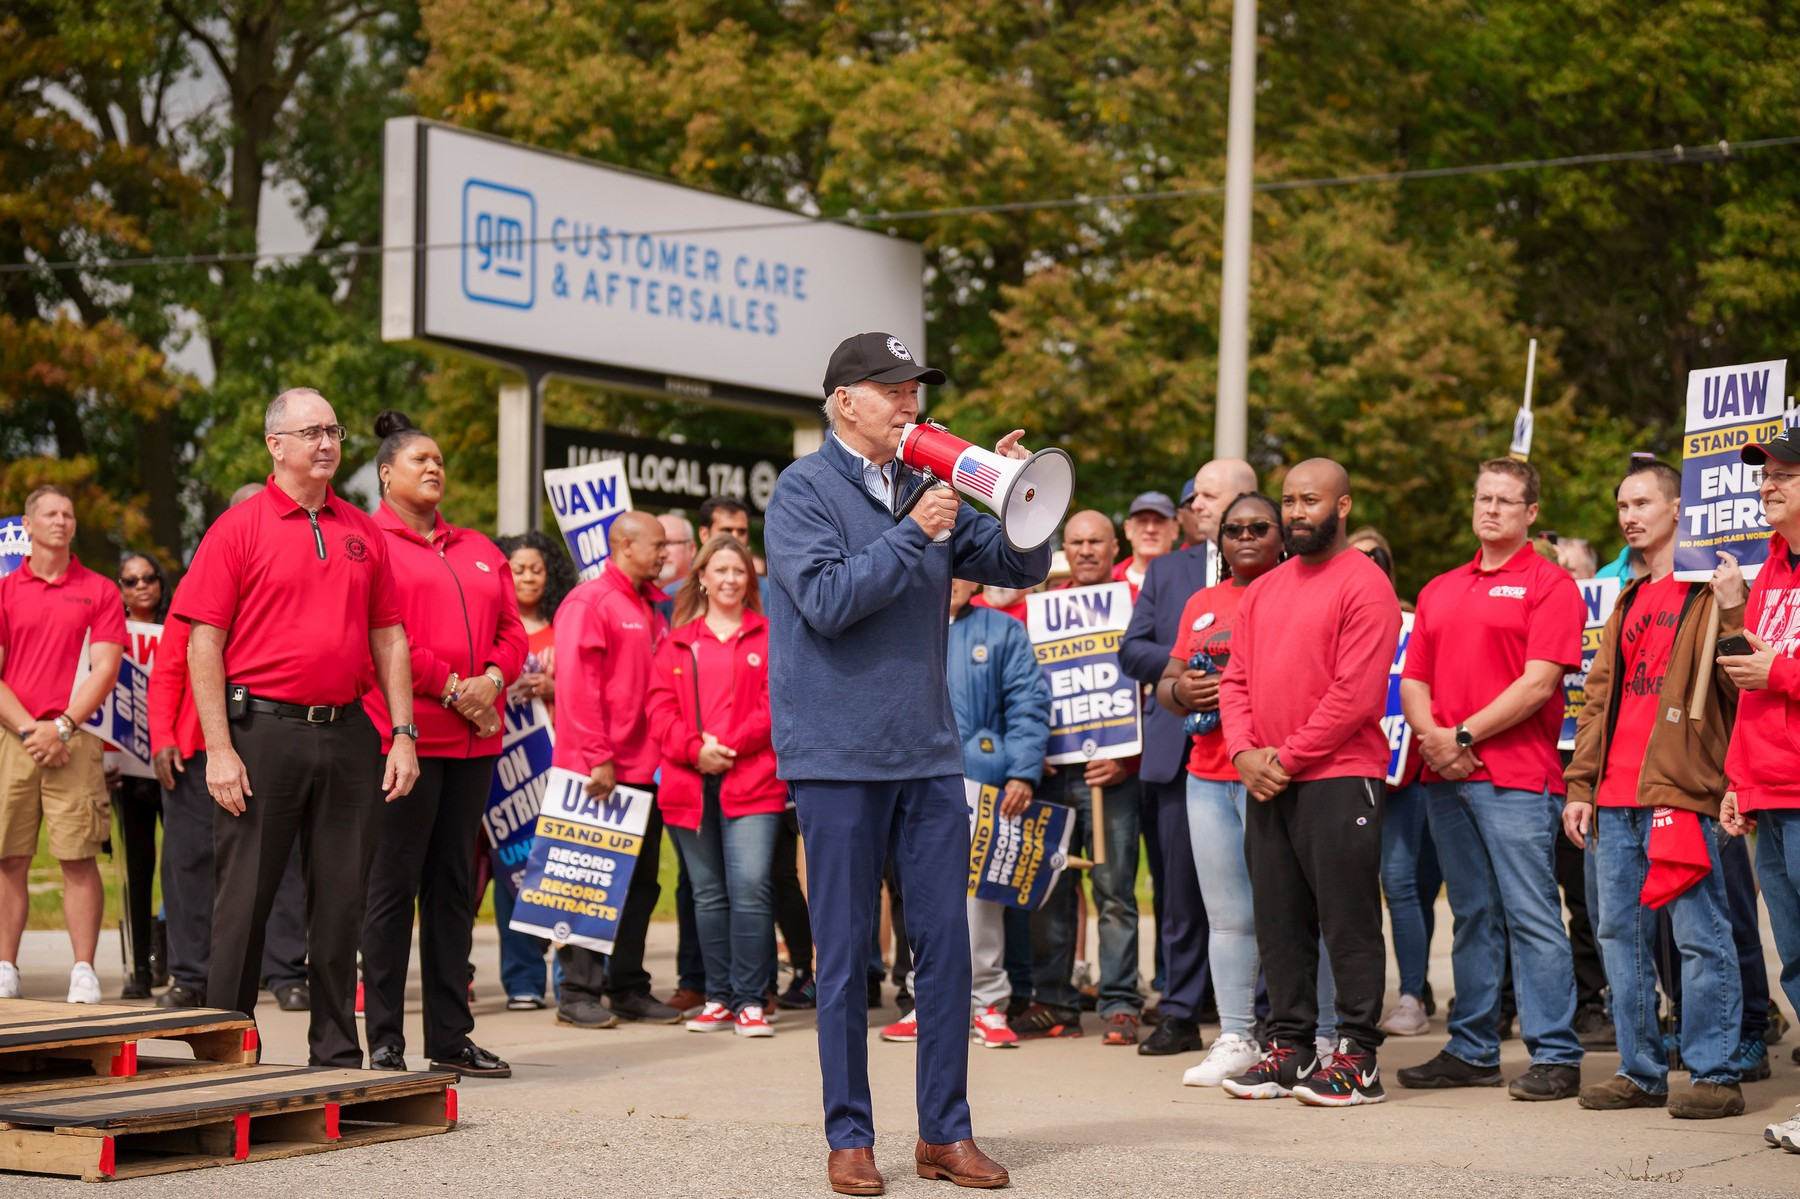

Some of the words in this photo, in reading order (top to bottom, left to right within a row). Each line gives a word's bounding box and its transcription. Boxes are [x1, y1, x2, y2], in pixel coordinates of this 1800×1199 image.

[477, 212, 522, 273] gm
[552, 216, 719, 283] CUSTOMER
[734, 255, 807, 301] CARE
[552, 262, 569, 298] &
[582, 269, 778, 335] AFTERSALES
[1703, 369, 1770, 420] UAW
[1690, 430, 1749, 454] STAND
[1756, 425, 1778, 443] UP
[550, 474, 617, 517] UAW
[628, 453, 707, 497] LOCAL
[707, 463, 747, 499] 174
[1700, 463, 1764, 500] END
[577, 523, 609, 566] ON
[1680, 540, 1693, 548] NO
[1693, 538, 1714, 547] MORE
[1723, 533, 1745, 544] CLASS
[1044, 591, 1113, 632] UAW
[1656, 611, 1680, 629] ON
[1038, 639, 1096, 660] STAND
[1050, 662, 1119, 698] END
[116, 682, 132, 723] ON
[131, 668, 150, 761] STRIKE
[1049, 688, 1134, 727] TIERS
[497, 744, 533, 792] ON
[488, 771, 551, 841] STRIK
[561, 778, 634, 826] UAW
[543, 822, 603, 844] STAND
[610, 835, 634, 850] UP
[967, 826, 990, 889] STAND
[982, 793, 992, 819] UP
[998, 814, 1022, 886] PROFITS
[1011, 818, 1035, 888] RECORD
[1017, 806, 1053, 905] CONTRACTS
[543, 860, 614, 888] PROFITS
[548, 846, 617, 873] RECORD
[521, 889, 619, 922] CONTRACTS
[539, 877, 609, 904] RECORD
